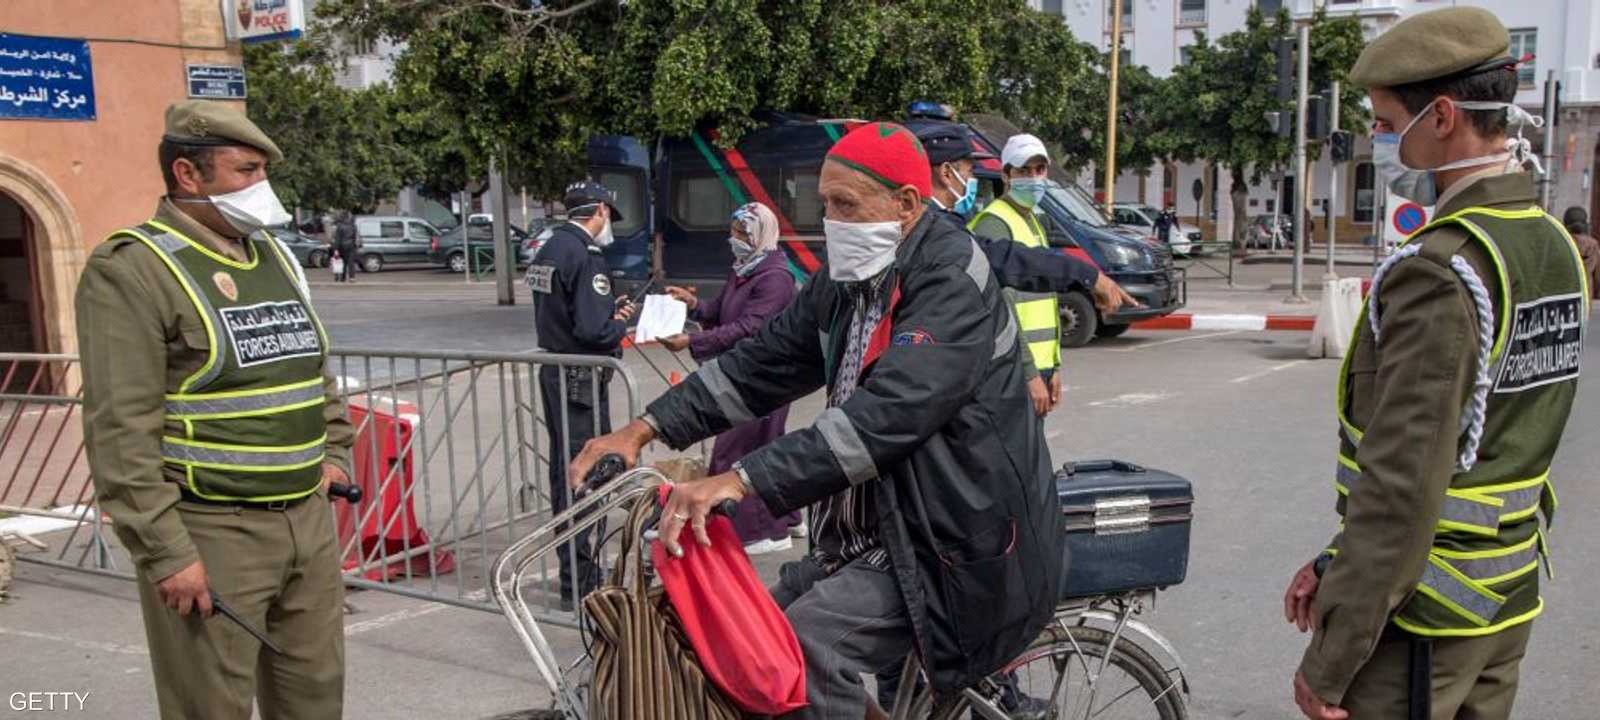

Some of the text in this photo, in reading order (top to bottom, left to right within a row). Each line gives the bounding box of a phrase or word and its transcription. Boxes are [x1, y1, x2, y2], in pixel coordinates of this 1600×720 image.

[255, 13, 288, 28] POLICE
[0, 67, 33, 77] الخميسا
[0, 85, 87, 109] مركز الشرط
[237, 334, 281, 360] FORCES
